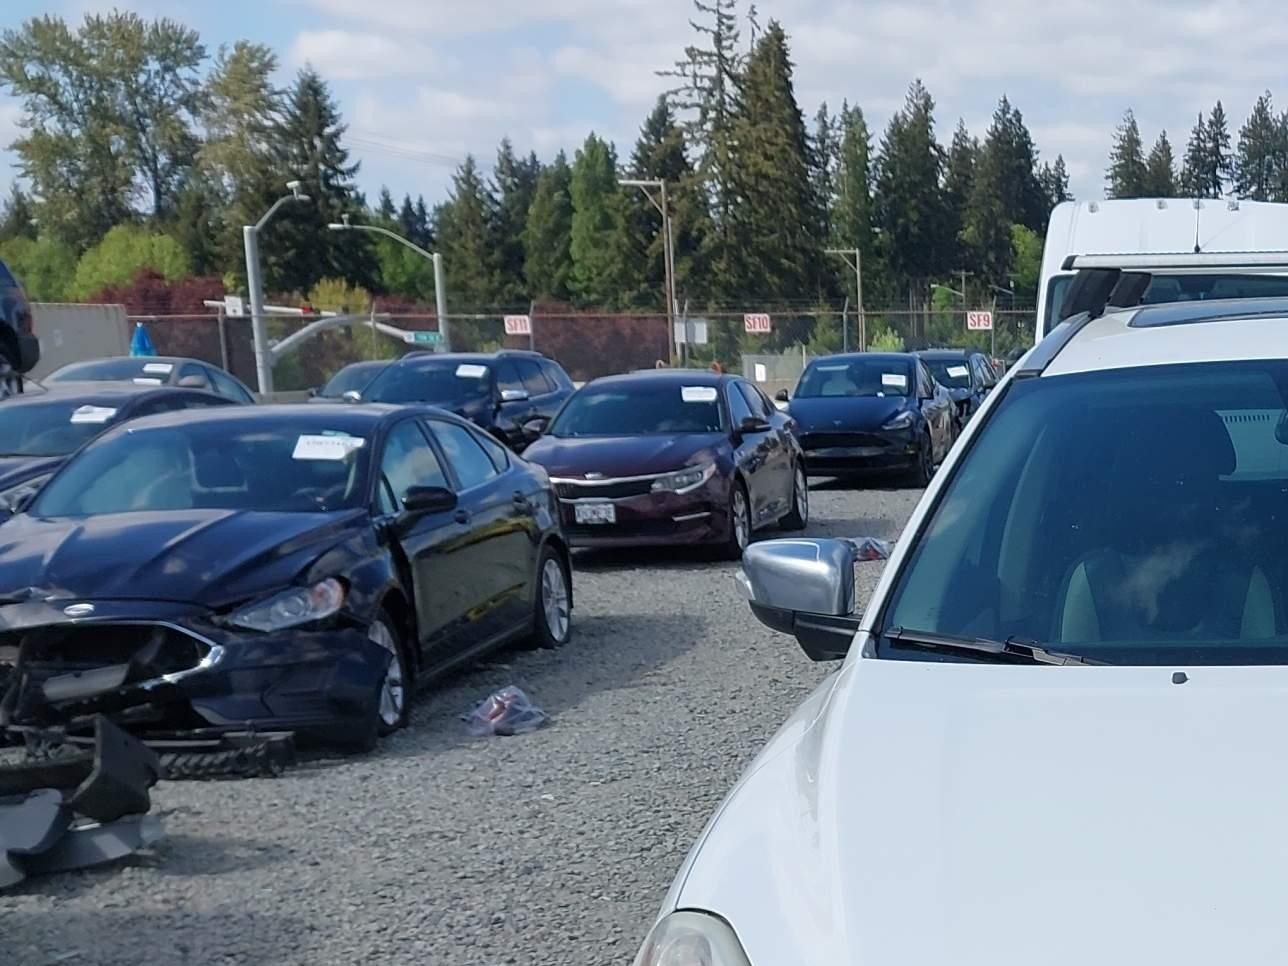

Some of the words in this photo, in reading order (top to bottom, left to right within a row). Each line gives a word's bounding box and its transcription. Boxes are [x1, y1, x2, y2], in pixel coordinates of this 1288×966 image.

[507, 317, 528, 332] SF11
[745, 315, 768, 330] SF10
[969, 313, 990, 328] SF9
